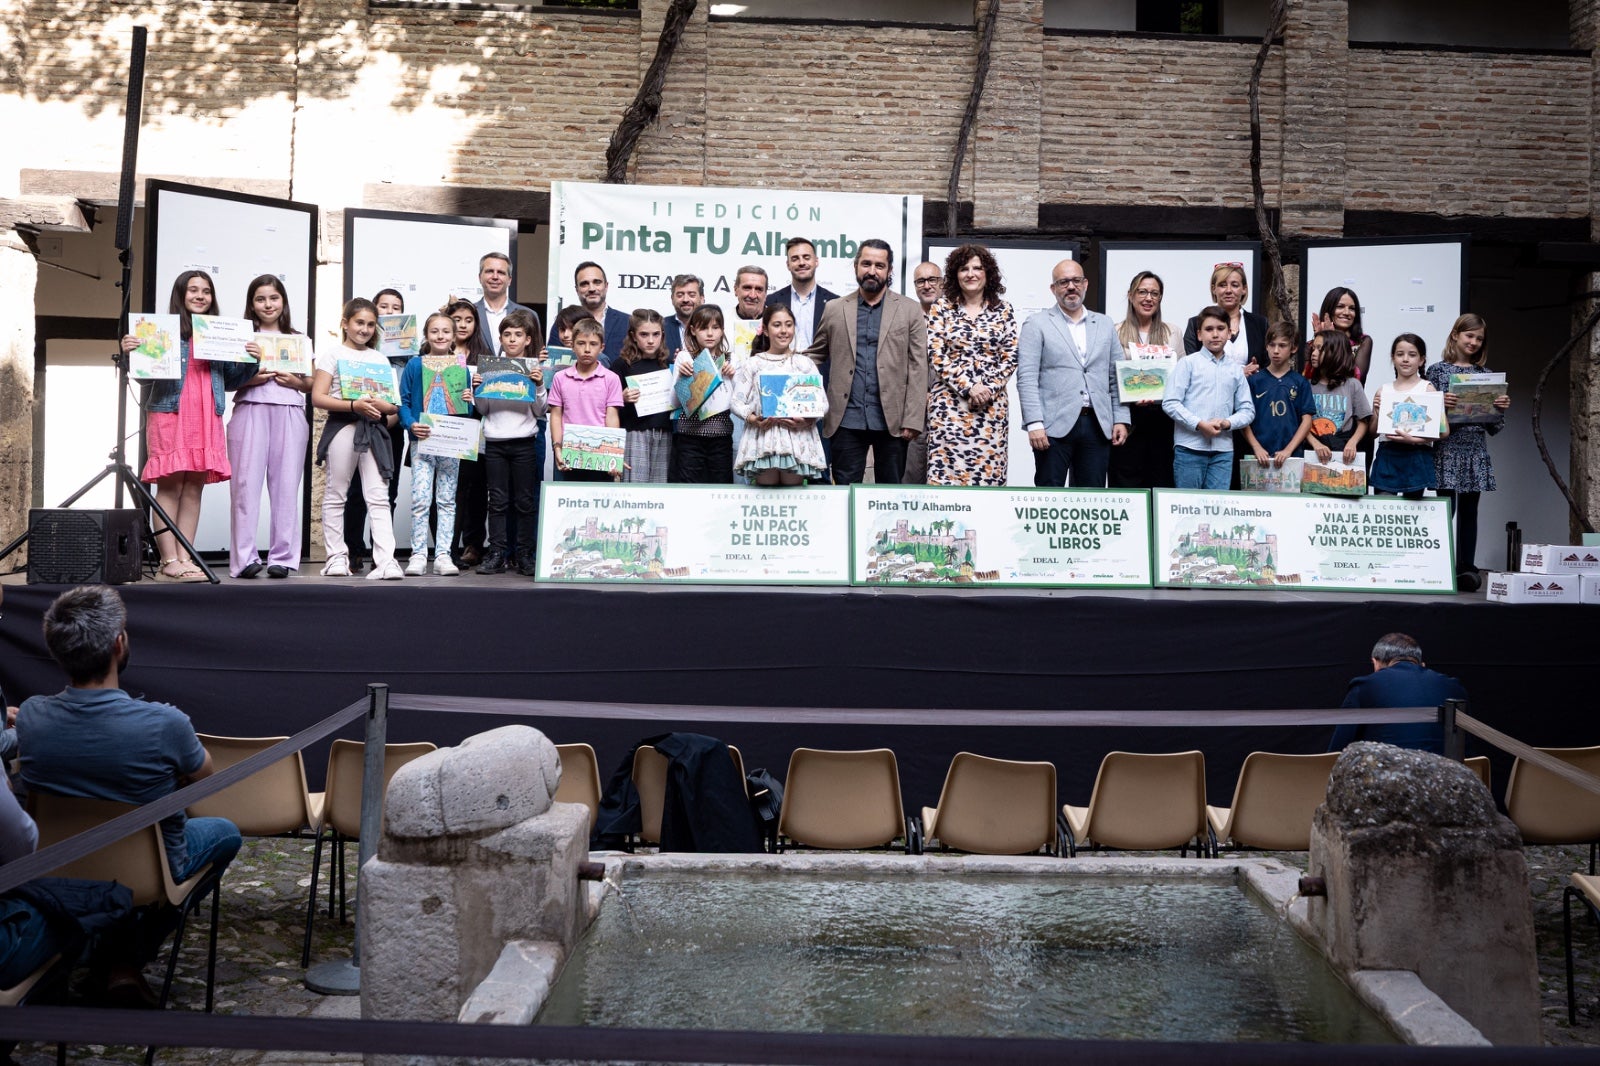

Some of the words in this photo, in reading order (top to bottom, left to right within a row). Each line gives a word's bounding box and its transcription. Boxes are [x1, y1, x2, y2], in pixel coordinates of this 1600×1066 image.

[652, 201, 673, 217] II
[695, 202, 822, 222] EDICIÓN
[582, 222, 672, 253] Pinta
[683, 226, 731, 255] TU
[741, 231, 864, 258] Alhmb
[618, 274, 674, 290] IDEA
[1269, 400, 1287, 416] 10
[558, 498, 589, 508] Pinta
[593, 499, 610, 508] TU
[613, 500, 664, 509] Alhambra
[868, 500, 899, 510] Pinta
[902, 501, 919, 511] TU
[922, 502, 972, 512] Alhambra
[741, 505, 798, 517] TABLET
[1014, 507, 1129, 521] VIDEOCONSOLA
[1171, 504, 1200, 515] Pinta
[1204, 506, 1219, 515] TU
[1223, 507, 1272, 517] Alhambra
[1323, 513, 1359, 523] VIAJE
[1362, 514, 1372, 524] A
[1374, 514, 1419, 525] DISNEY
[730, 521, 738, 530] +
[743, 520, 764, 531] UN
[769, 520, 808, 532] PACK
[1024, 524, 1031, 532] +
[1036, 522, 1056, 534] UN
[1061, 523, 1098, 535] PACK
[1103, 523, 1121, 535] DE
[1315, 524, 1348, 535] PARA
[1352, 526, 1360, 535] 4
[1363, 526, 1429, 537] PERSONAS
[731, 534, 751, 545] DE
[756, 534, 810, 546] LIBROS
[1049, 537, 1101, 549] LIBROS
[1308, 536, 1316, 546] Y
[1320, 536, 1337, 546] UN
[1341, 537, 1372, 548] PACK
[1377, 538, 1392, 548] DE
[1396, 538, 1440, 549] LIBROS
